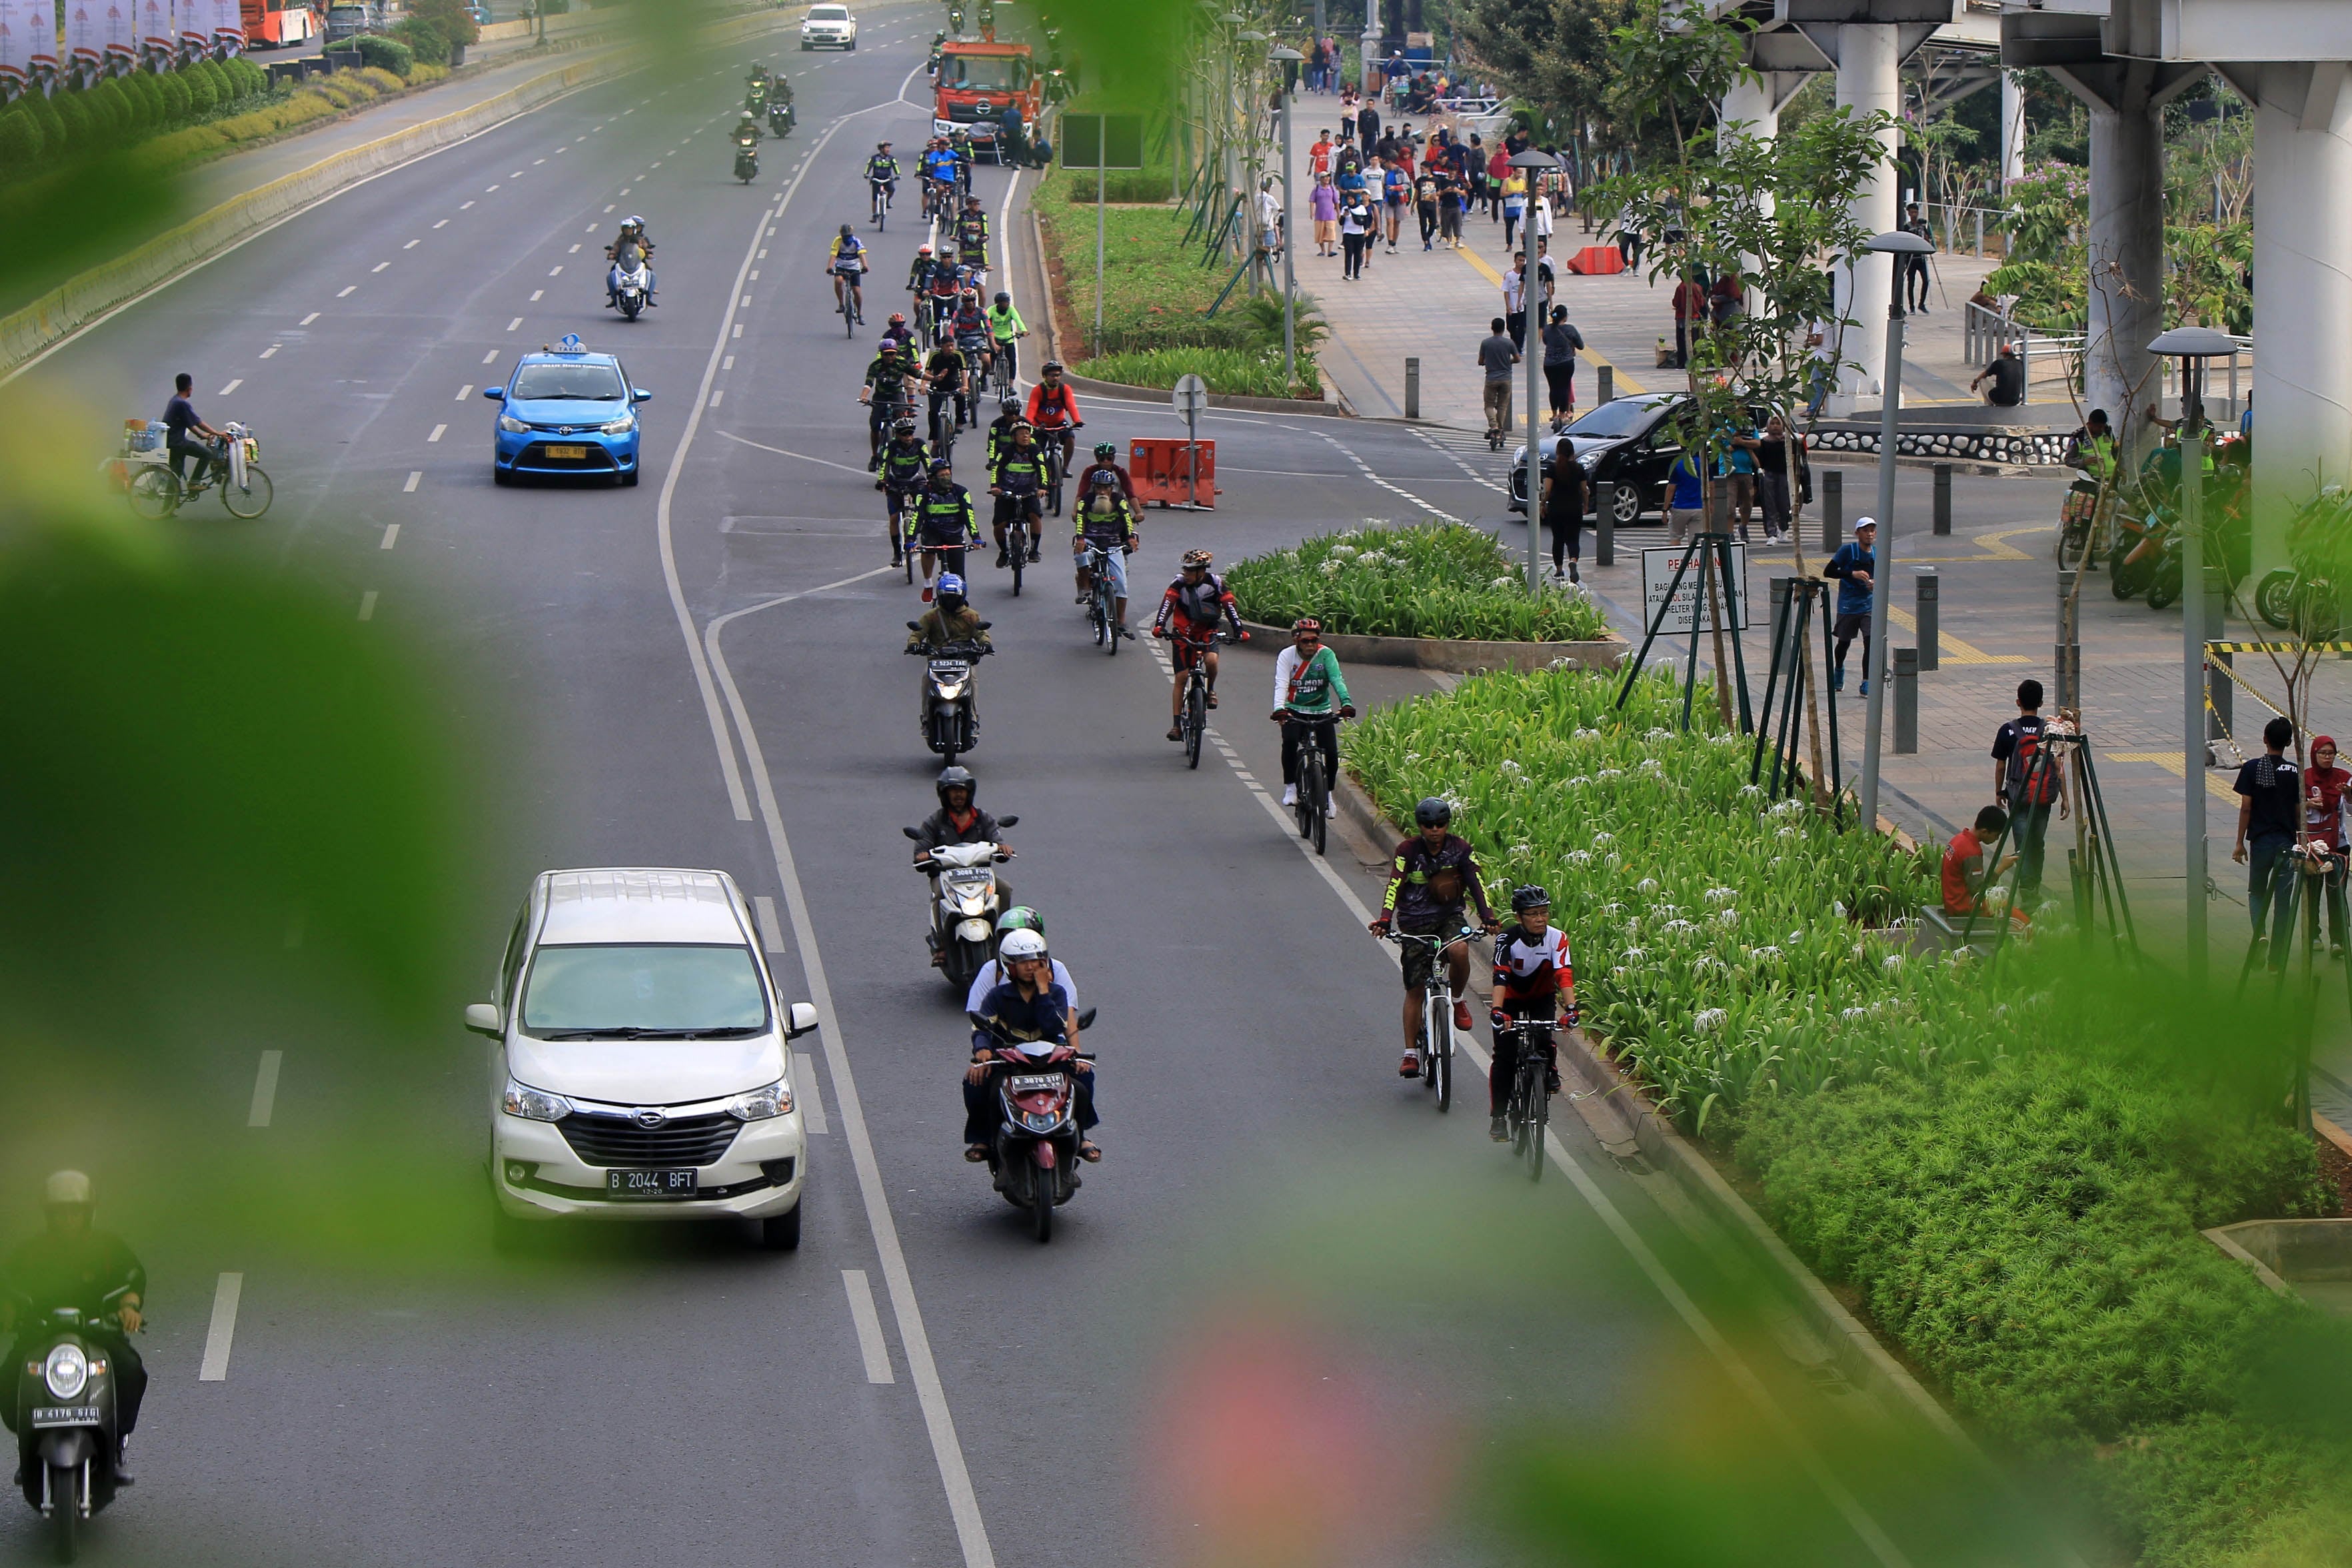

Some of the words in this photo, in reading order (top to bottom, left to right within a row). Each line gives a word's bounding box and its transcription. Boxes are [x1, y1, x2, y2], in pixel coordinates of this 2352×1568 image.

[1668, 557, 1722, 569] PEHAN
[1648, 594, 1664, 603] ATAU
[1665, 604, 1690, 613] HELTER
[1383, 877, 1402, 911] THOR
[612, 1173, 620, 1188] B
[628, 1172, 658, 1187] 2044
[669, 1172, 692, 1187] BFT
